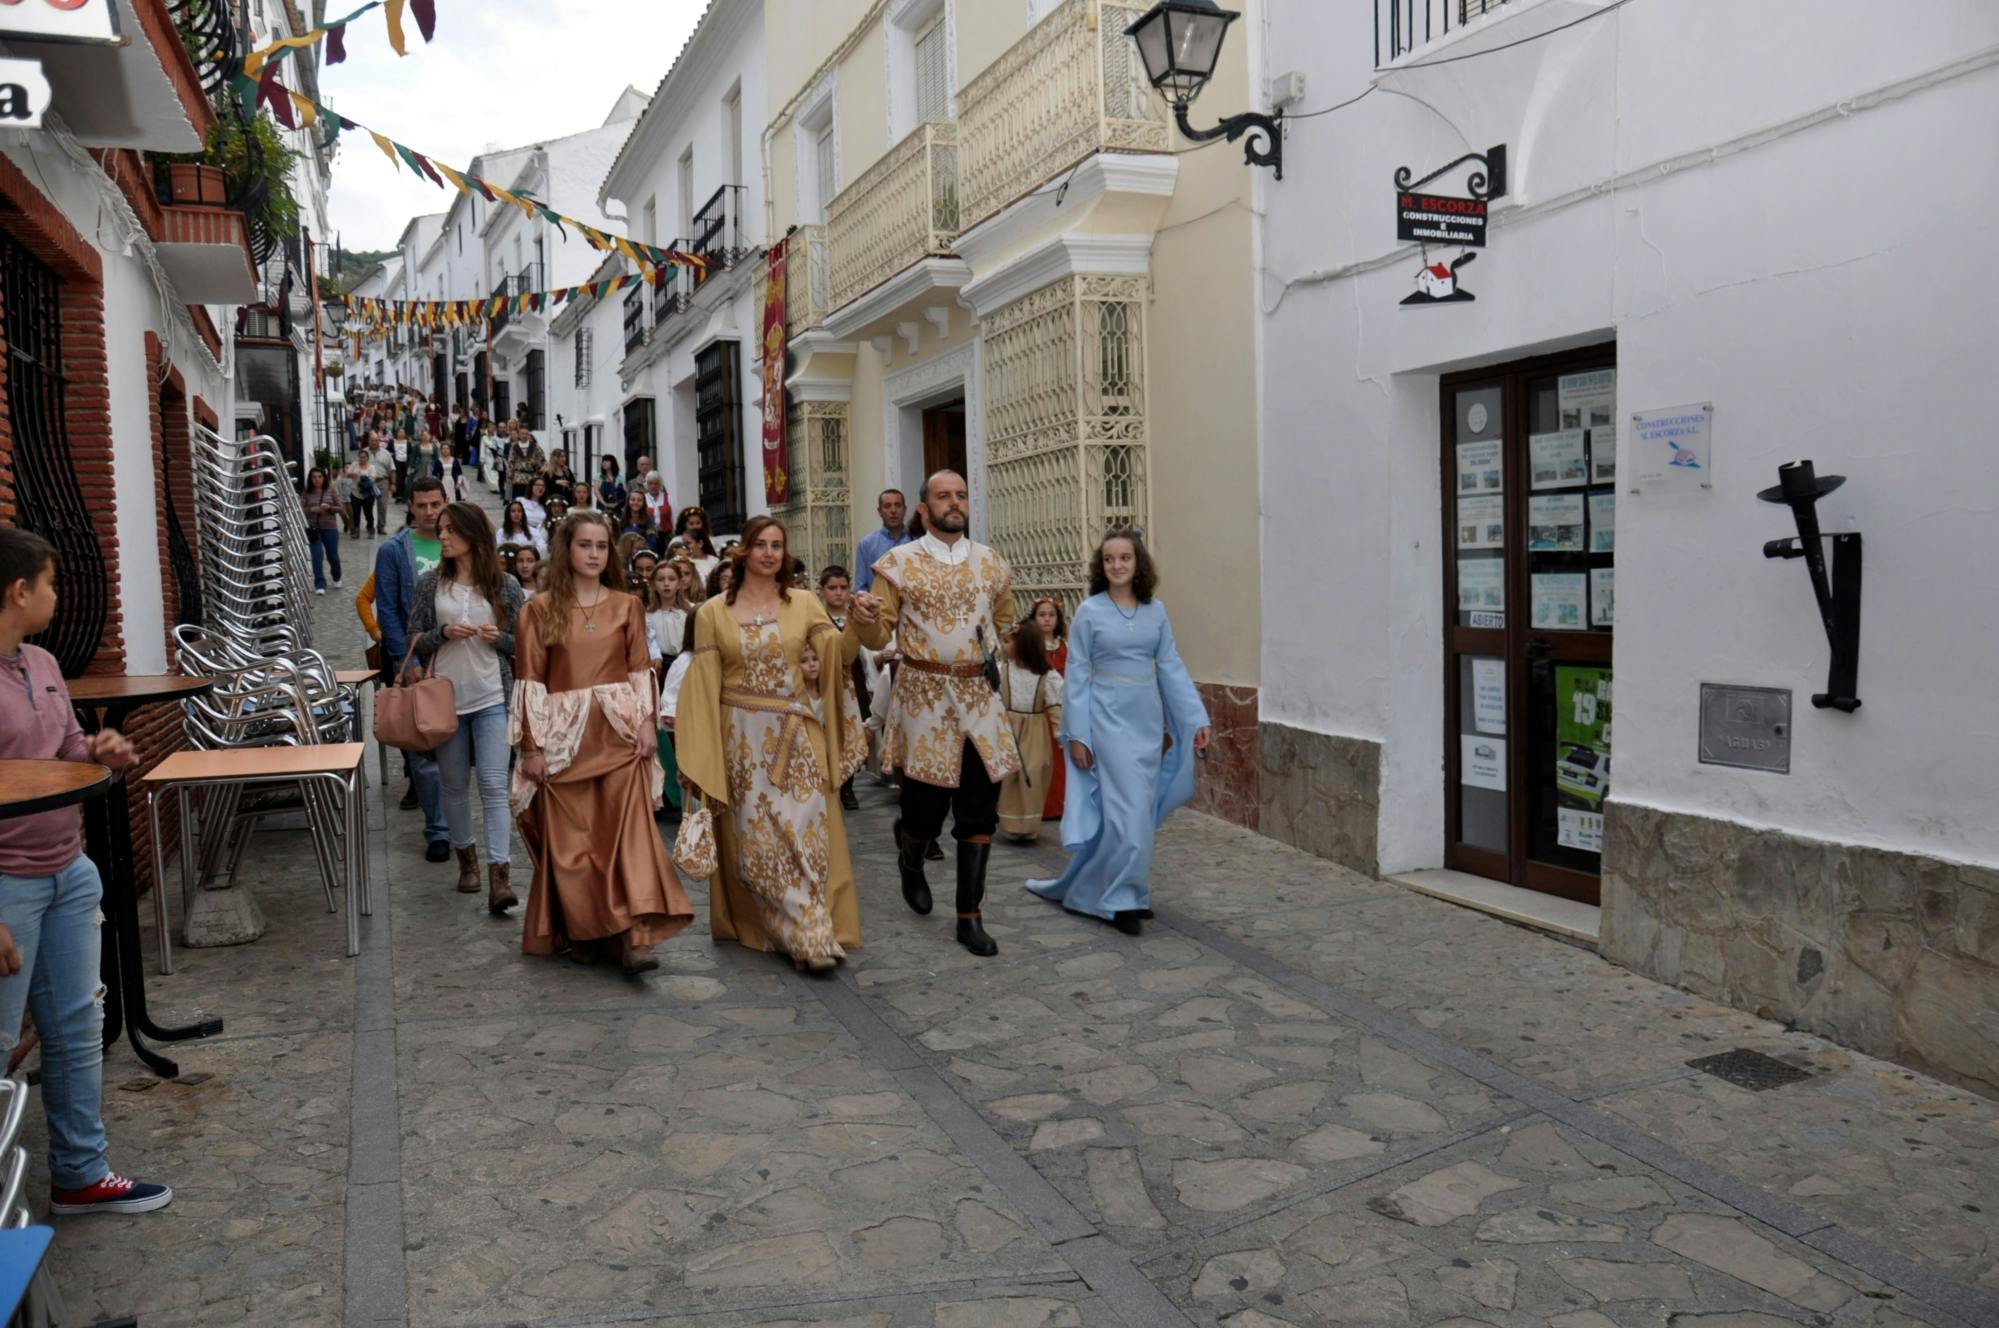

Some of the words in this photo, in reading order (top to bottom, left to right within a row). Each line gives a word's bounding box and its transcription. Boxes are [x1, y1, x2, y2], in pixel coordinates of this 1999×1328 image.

[1401, 195, 1416, 209] M.
[1421, 198, 1485, 214] ESCORZA
[1402, 212, 1484, 225] CONSTRUCCIONES
[1413, 228, 1474, 240] INMOBILIARIA
[1635, 415, 1705, 431] CONSTRUCCIONES
[1649, 427, 1685, 440] ESCORZA
[1473, 614, 1504, 628] ABIERTO
[1573, 690, 1597, 726] 19
